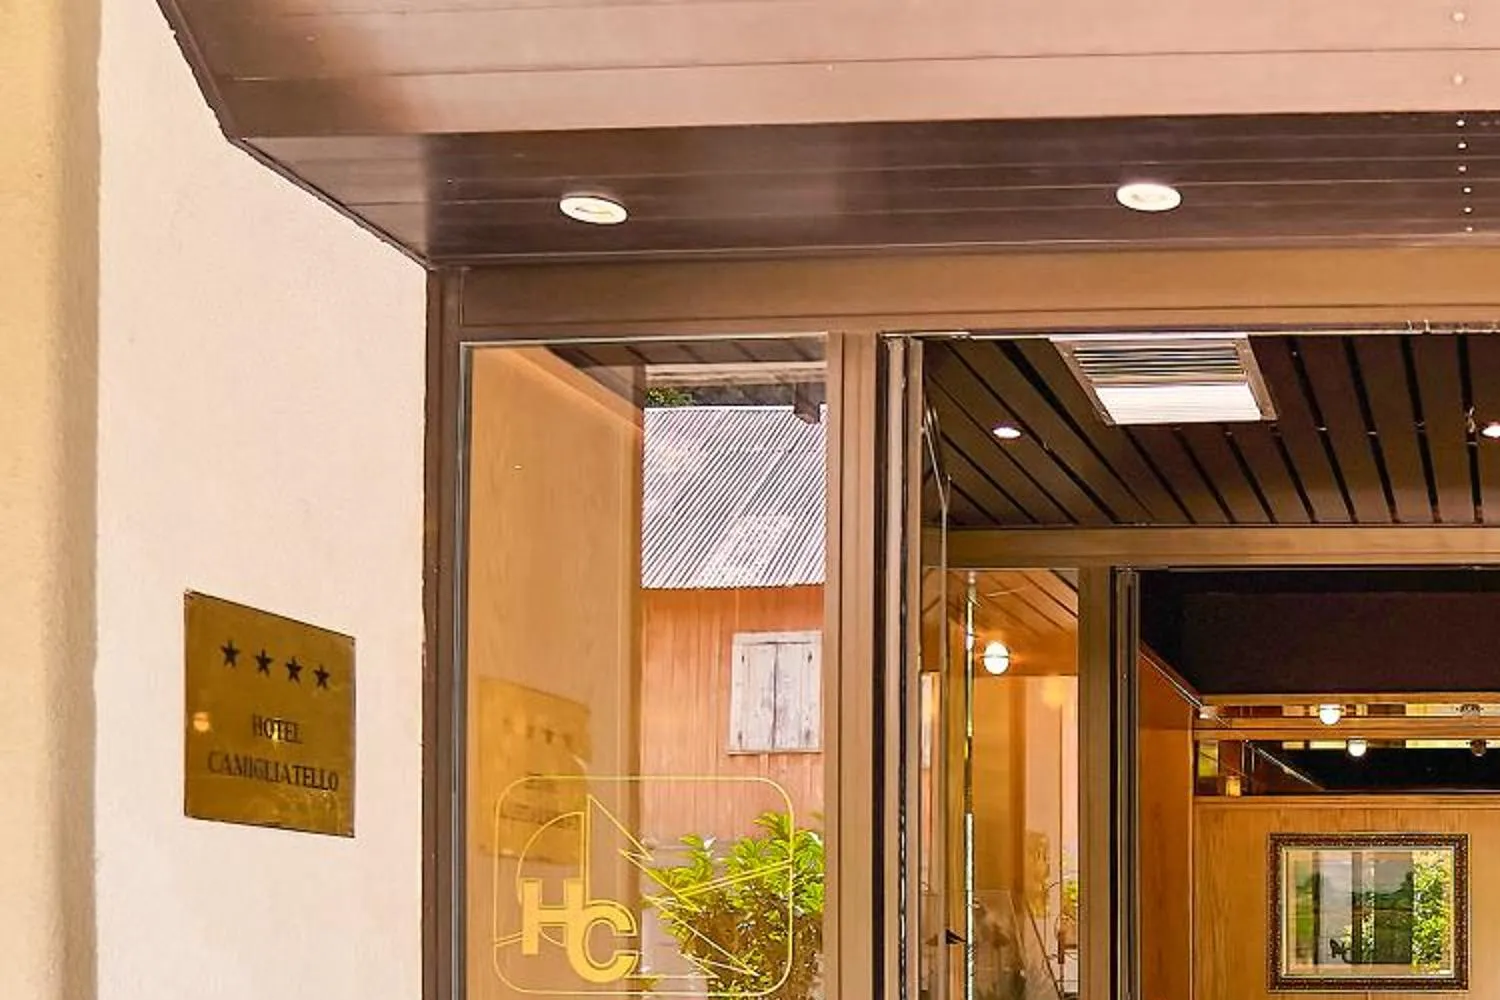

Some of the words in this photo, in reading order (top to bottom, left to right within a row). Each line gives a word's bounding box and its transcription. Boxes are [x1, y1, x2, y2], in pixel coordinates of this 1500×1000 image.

[252, 714, 303, 744] HOTEL
[207, 750, 339, 791] CAMIGLIATELLO
[521, 878, 638, 983] HC
